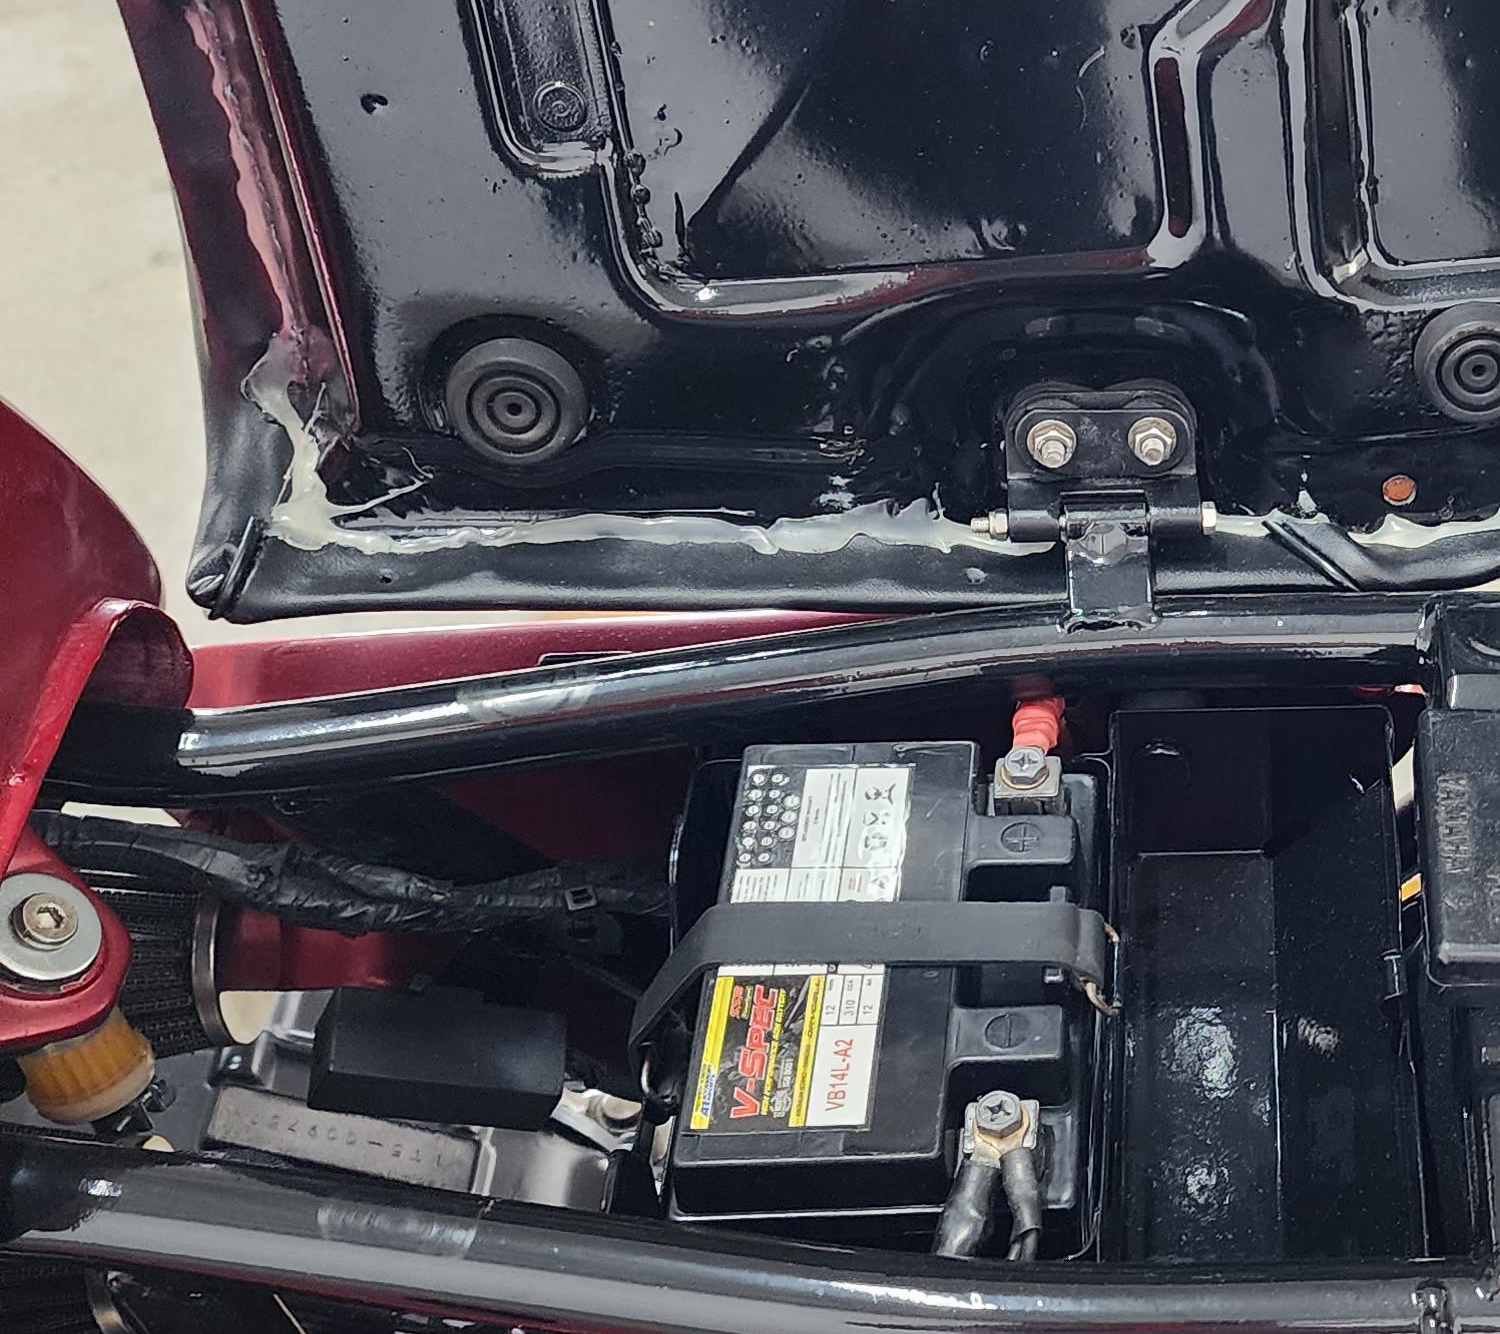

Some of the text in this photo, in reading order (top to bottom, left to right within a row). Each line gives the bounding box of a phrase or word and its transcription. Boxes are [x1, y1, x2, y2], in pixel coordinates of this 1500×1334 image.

[1436, 774, 1471, 873] YAMAHA
[825, 1004, 836, 1015] 12
[843, 999, 856, 1017] 310
[862, 1004, 874, 1015] 12
[729, 984, 778, 1118] V-SPEC
[825, 1038, 854, 1112] VB14L-A2
